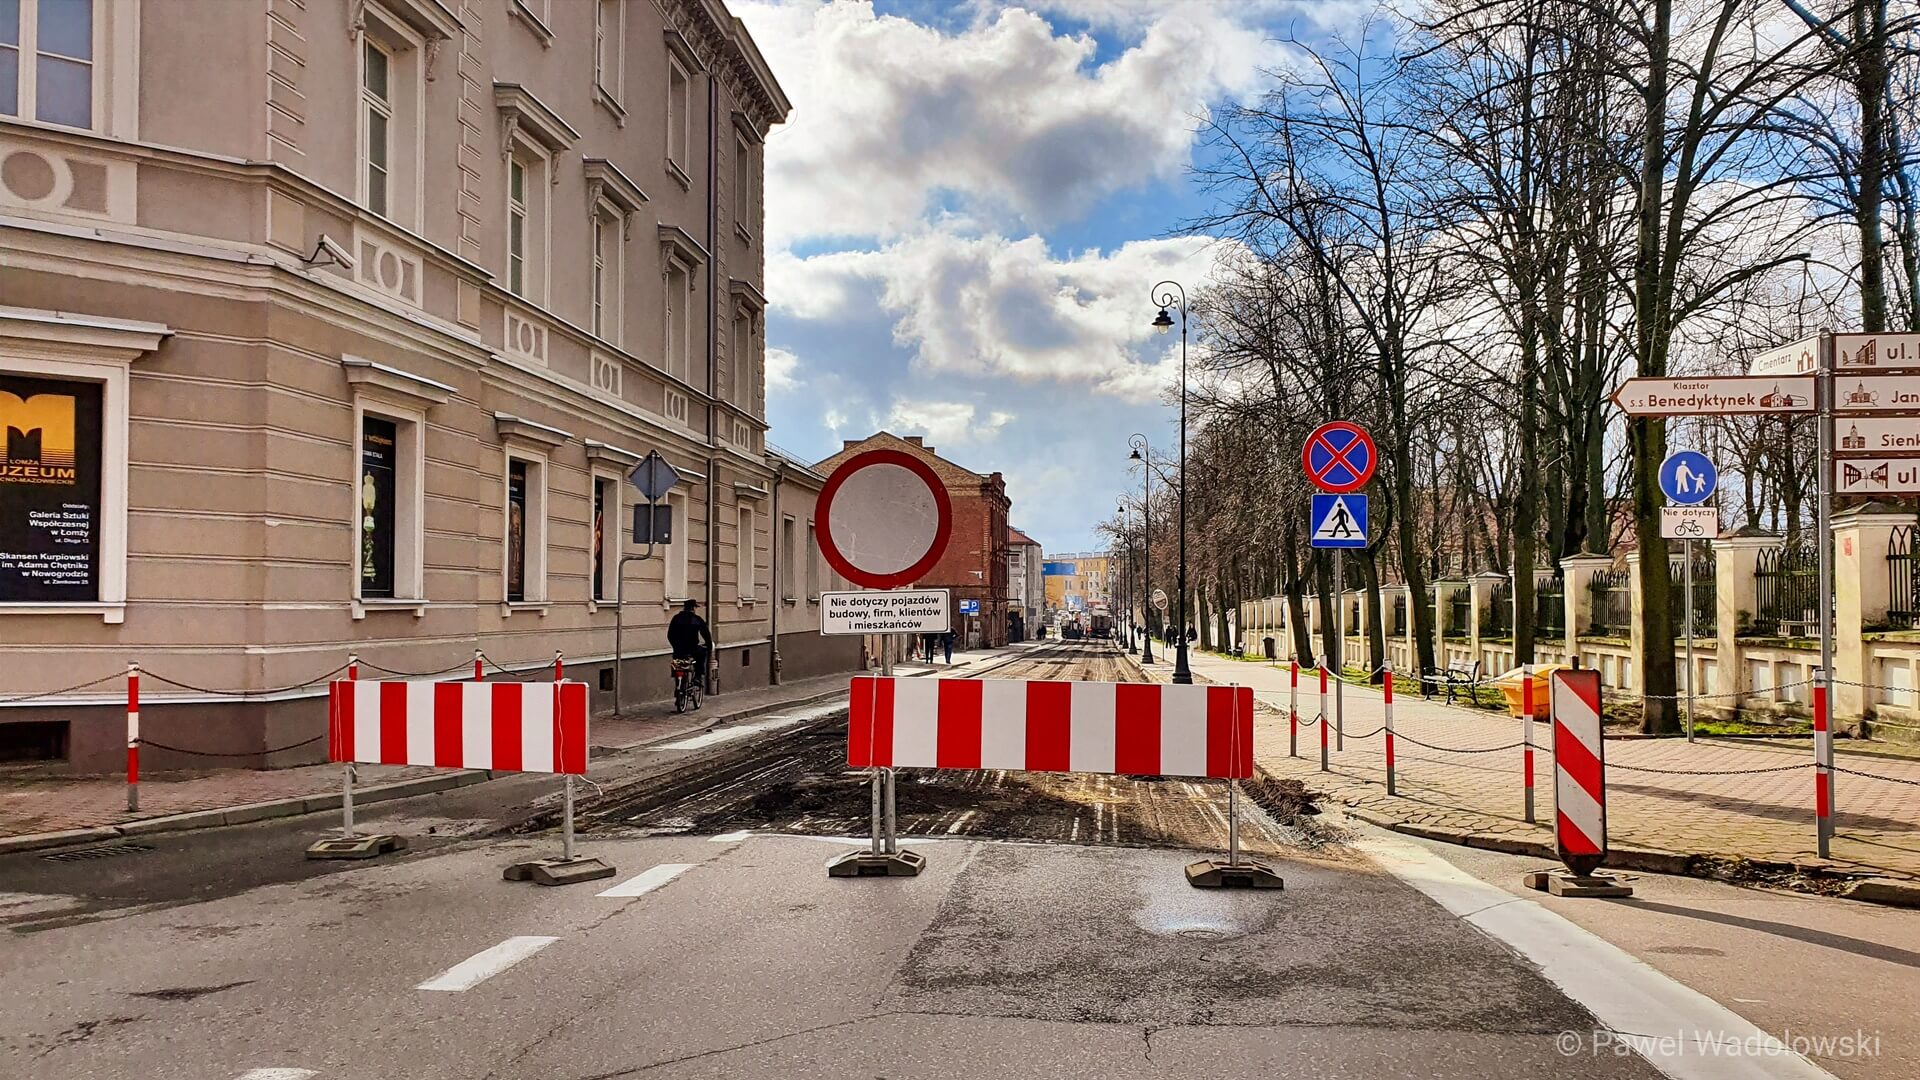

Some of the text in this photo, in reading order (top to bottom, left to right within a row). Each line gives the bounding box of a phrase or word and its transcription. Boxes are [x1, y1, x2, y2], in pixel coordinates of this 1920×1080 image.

[1887, 342, 1912, 360] ul.
[1758, 353, 1792, 371] Cmentarz
[1673, 382, 1709, 390] Klasztor
[1648, 393, 1755, 410] Benedyktynek
[29, 511, 60, 519] Galeria
[1682, 509, 1716, 518] dotyczy
[29, 519, 89, 529] Współczesnej
[60, 529, 89, 537] Łomży
[0, 552, 89, 561] Skansen Kurpiowski
[50, 562, 89, 570] Chętnika
[31, 570, 89, 578] Nowogrodzie
[830, 595, 940, 608] Nie dotyczy pojazdów
[829, 607, 941, 620] budowy, firm, klientów
[848, 619, 922, 630] i mieszkańców
